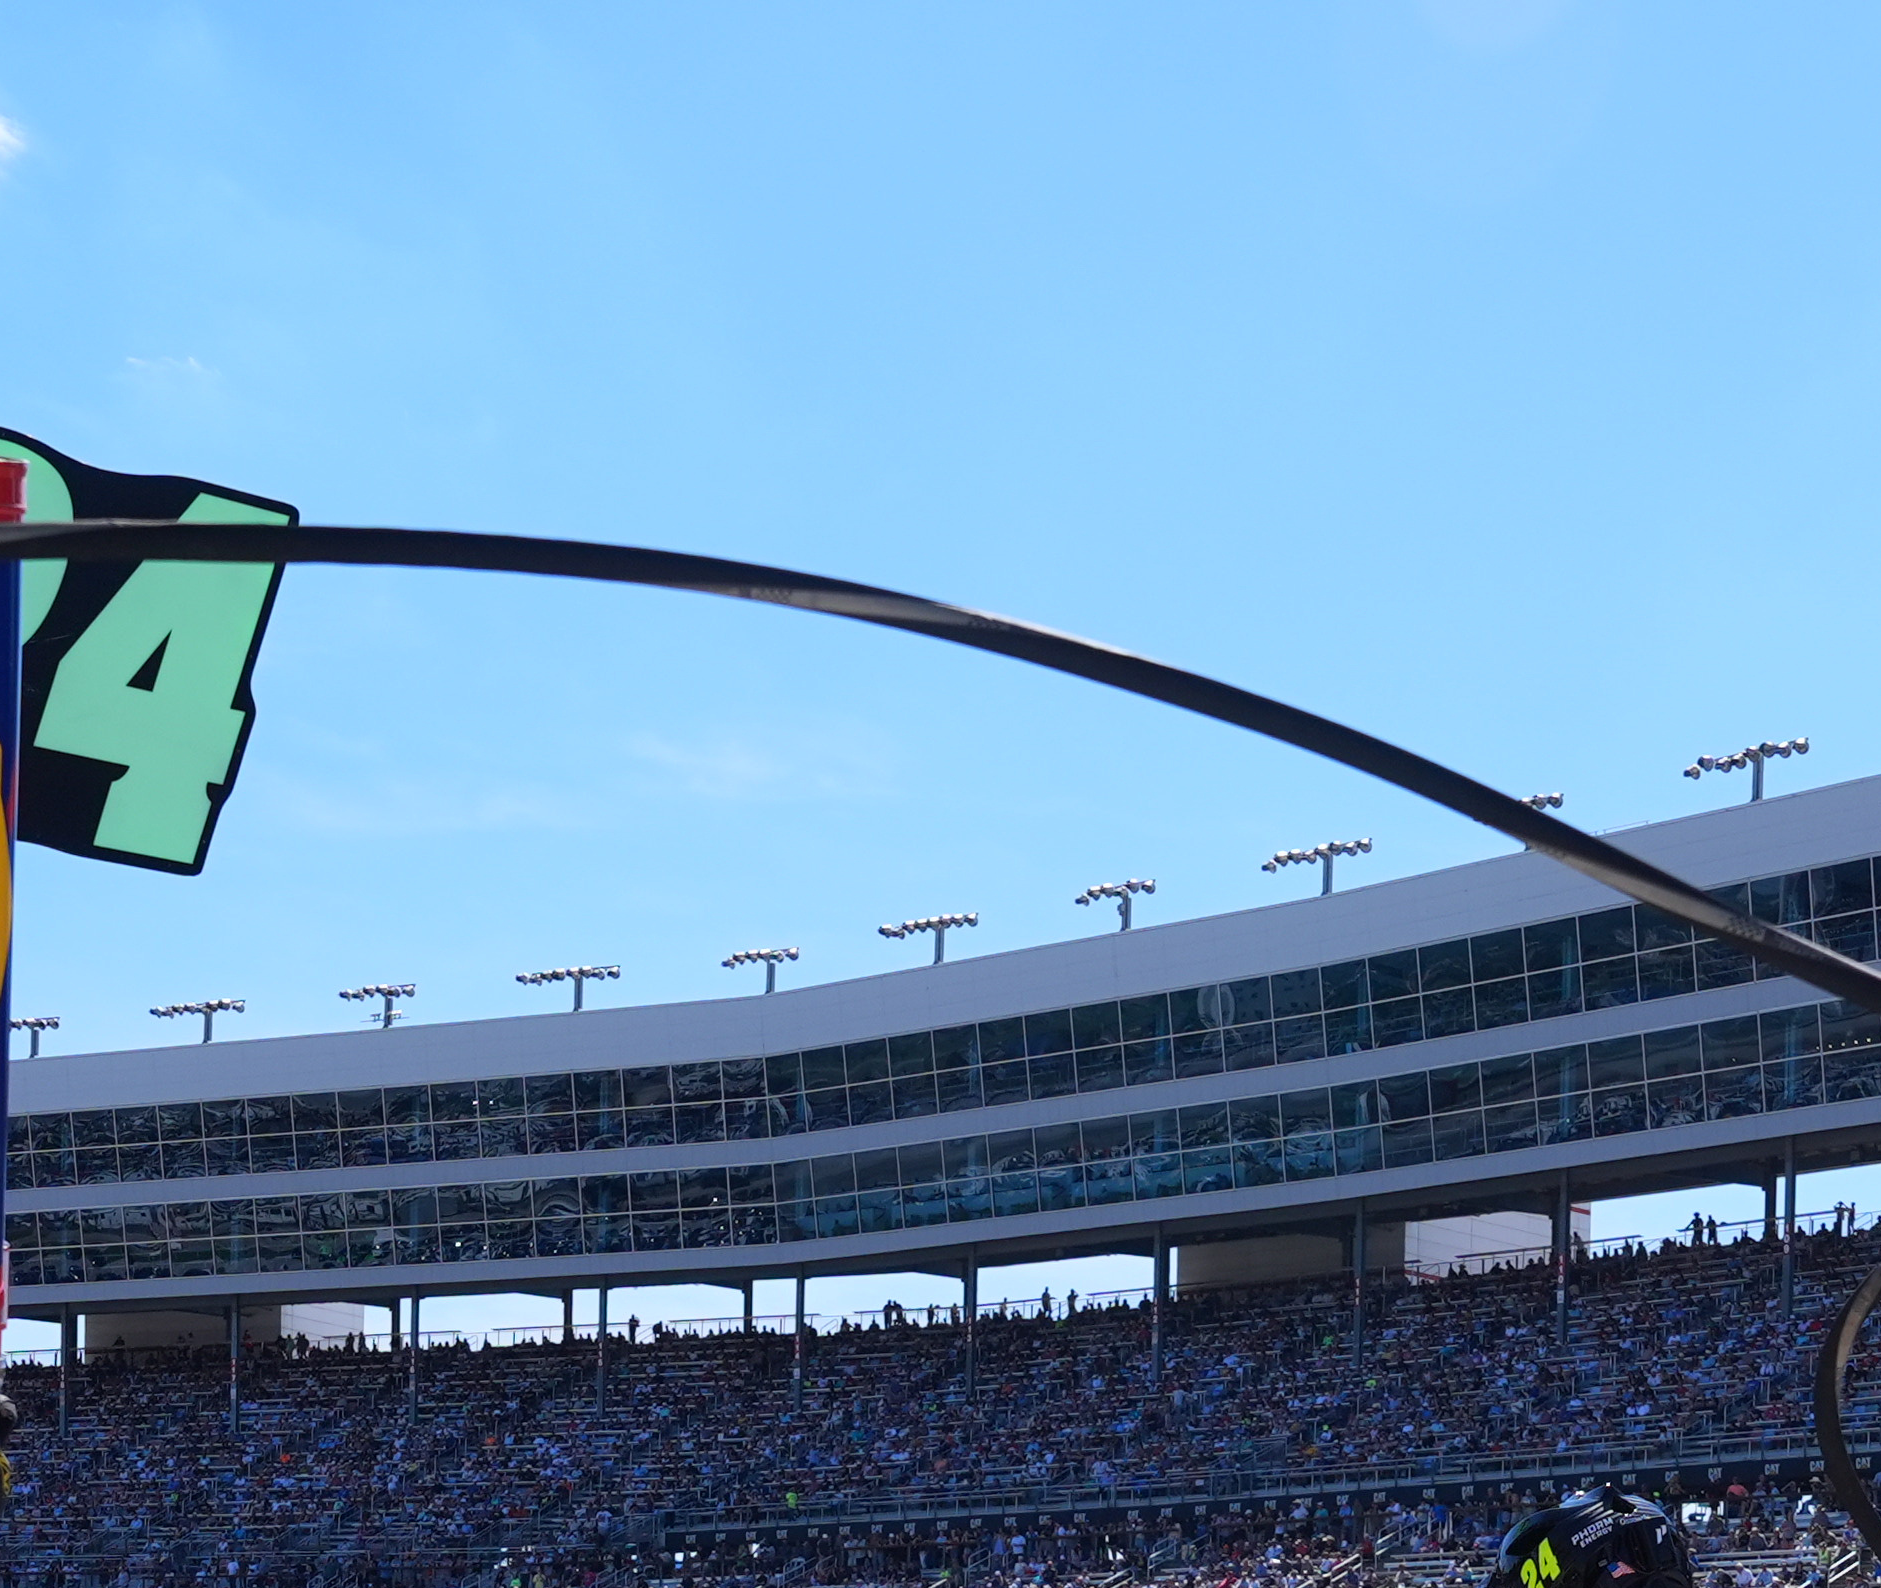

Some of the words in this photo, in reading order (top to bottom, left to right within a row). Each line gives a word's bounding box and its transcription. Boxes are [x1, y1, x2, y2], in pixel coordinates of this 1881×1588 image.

[1810, 1460, 1824, 1471] CAT
[1855, 1457, 1871, 1469] CAT
[1708, 1467, 1722, 1479] CAT
[1765, 1464, 1780, 1475] CAT
[1622, 1474, 1636, 1484] CAT
[1571, 1517, 1614, 1546] PHORM
[1580, 1525, 1613, 1549] ENERGY
